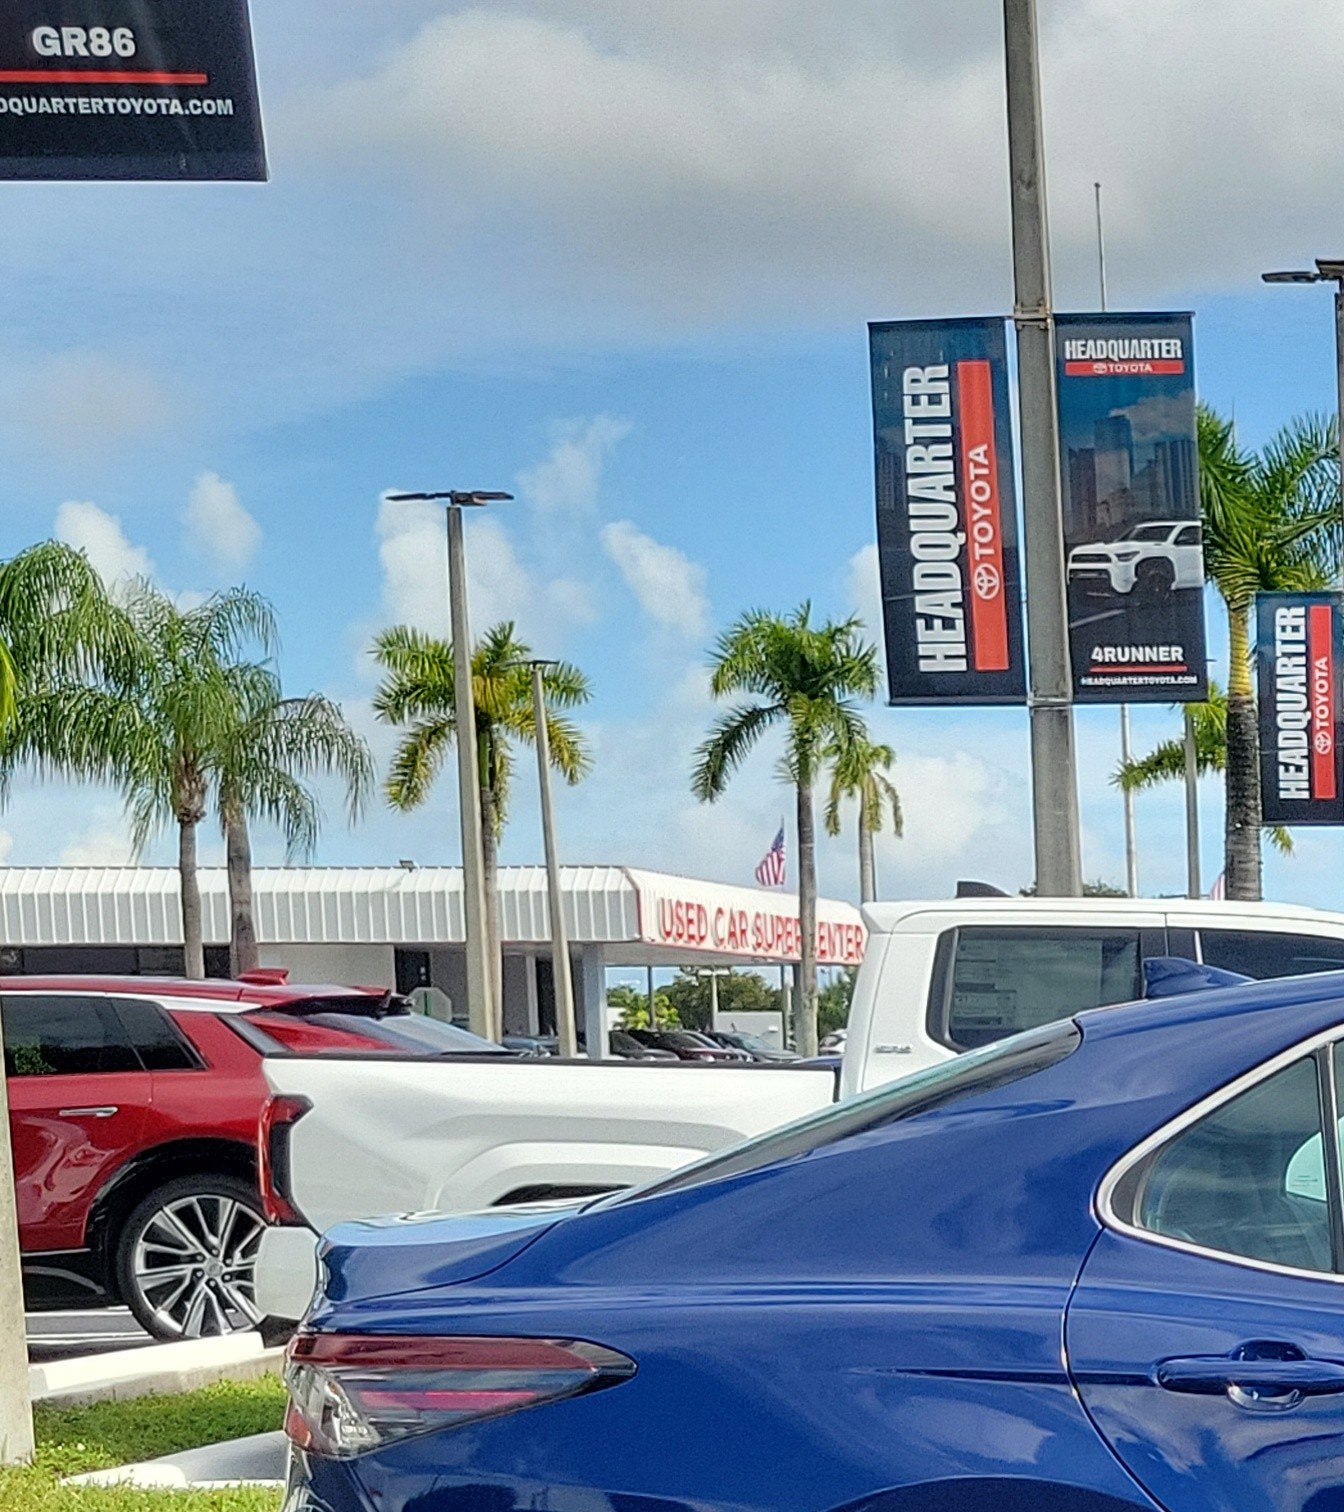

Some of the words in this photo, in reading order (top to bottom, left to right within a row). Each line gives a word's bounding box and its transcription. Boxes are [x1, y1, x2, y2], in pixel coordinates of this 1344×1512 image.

[32, 26, 136, 57] GR86
[1064, 339, 1182, 361] HEADQUARTER
[1107, 363, 1154, 373] TOYOTA
[903, 364, 967, 673] HEADQUARTER
[969, 444, 998, 560] TOYOTA
[1090, 645, 1185, 662] 4RUNNER
[1275, 606, 1311, 800] HEADQUARTER
[1314, 656, 1330, 730] TOYOTA
[660, 897, 709, 943] USED
[714, 907, 750, 949] CAR
